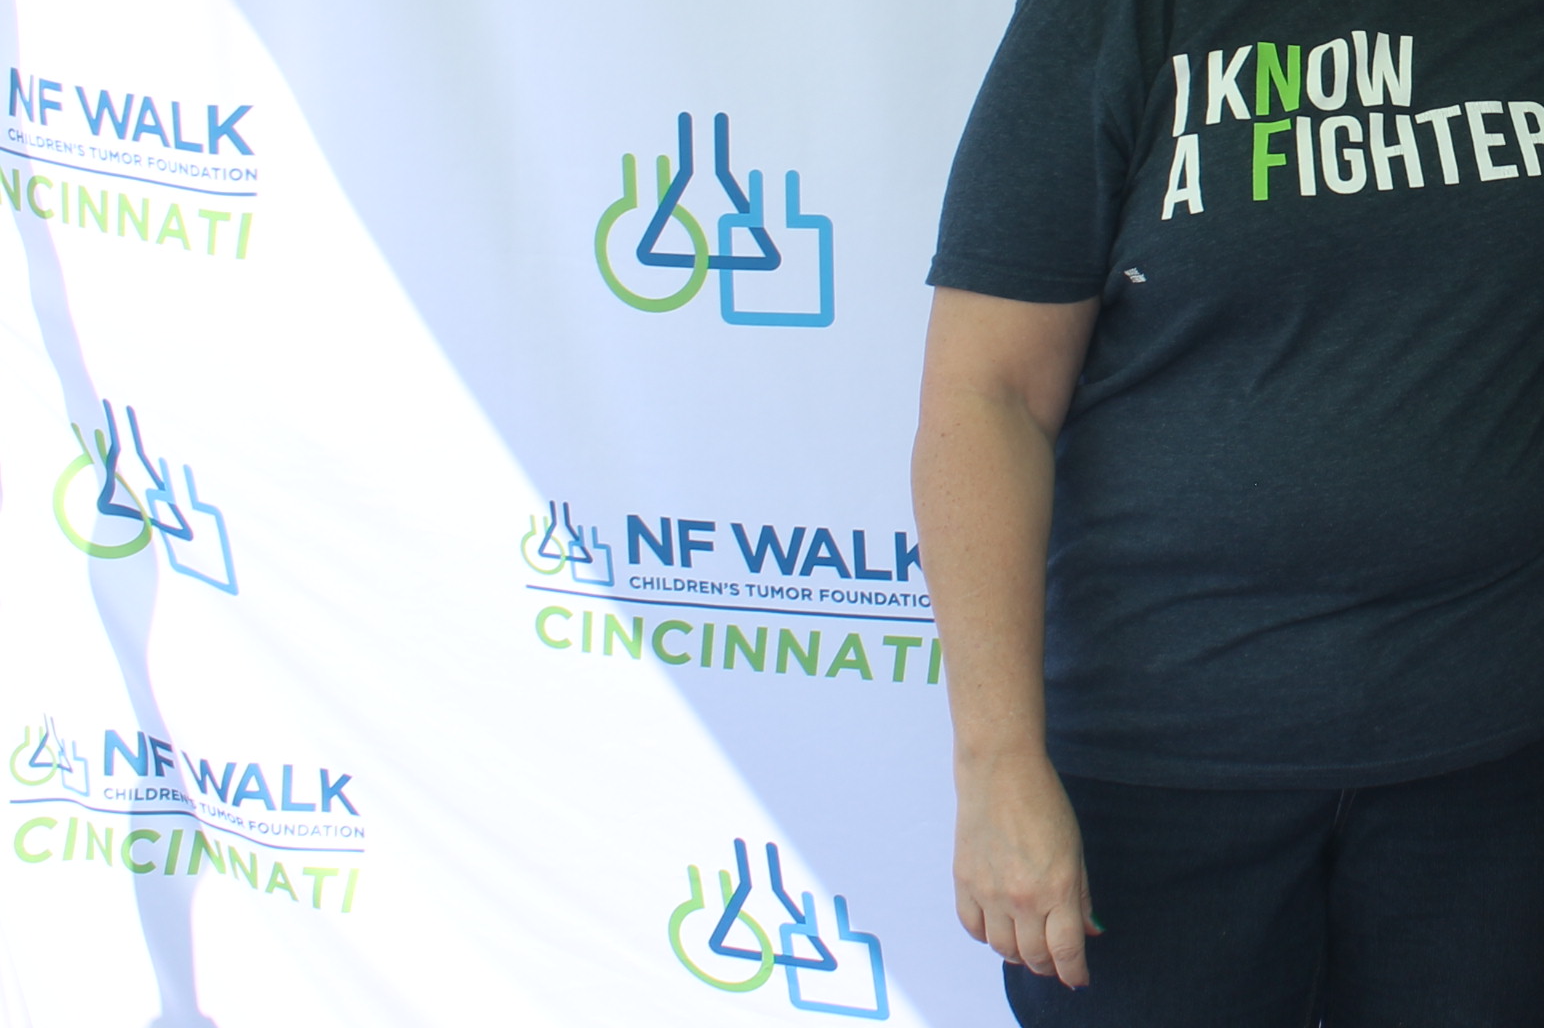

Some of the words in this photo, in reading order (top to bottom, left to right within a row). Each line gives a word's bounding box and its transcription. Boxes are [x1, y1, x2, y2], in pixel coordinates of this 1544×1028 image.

[9, 66, 63, 126] NF
[74, 85, 255, 156] WALK
[1172, 53, 1191, 137] I
[1205, 30, 1413, 125] KNOW
[8, 128, 85, 157] CHILDREN'S
[89, 147, 143, 167] TUMOR
[147, 157, 258, 181] FOUNDATION
[1161, 133, 1204, 221] A
[627, 514, 716, 569] NF
[730, 522, 922, 582] WALK
[629, 575, 740, 596] CHILDREN'S
[745, 583, 813, 602] TUMOR
[535, 605, 942, 685] CINCINNATI
[104, 729, 174, 778] NF
[181, 750, 360, 817] WALK
[199, 802, 244, 829] TUMOR
[248, 819, 365, 839] FOUNDATION
[14, 816, 359, 913] CINCINNATI
